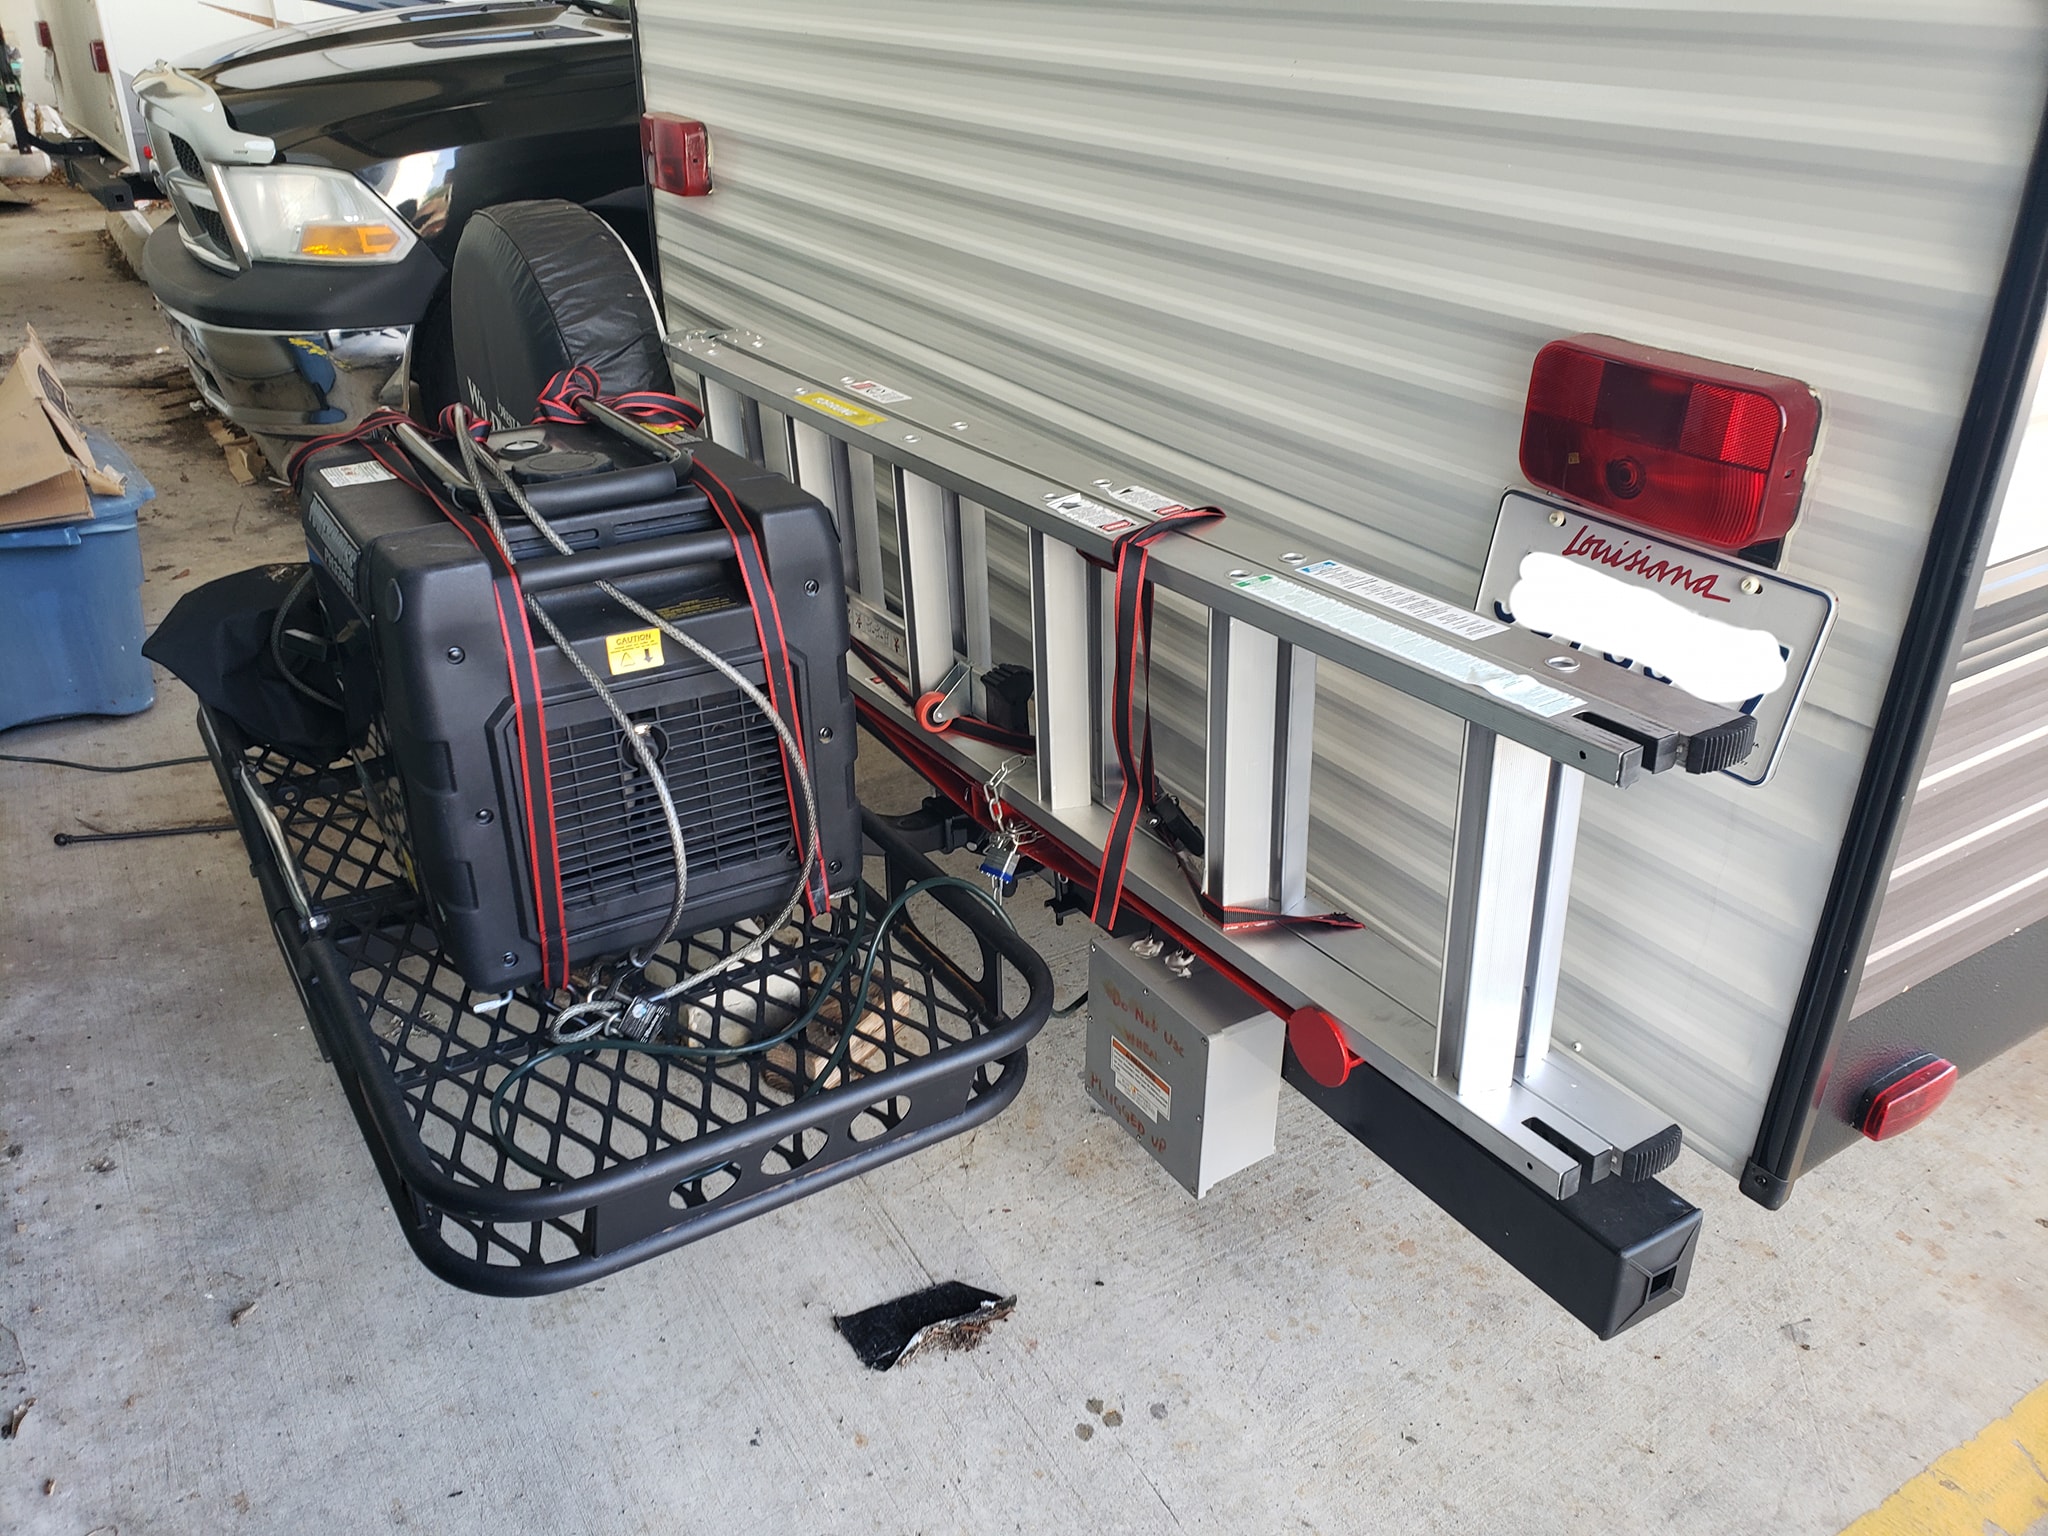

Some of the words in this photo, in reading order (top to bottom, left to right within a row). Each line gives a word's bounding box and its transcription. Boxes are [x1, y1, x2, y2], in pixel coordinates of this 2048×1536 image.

[466, 375, 507, 431] WILD
[1562, 525, 1731, 604] Louisiana
[615, 633, 652, 646] CAUTION
